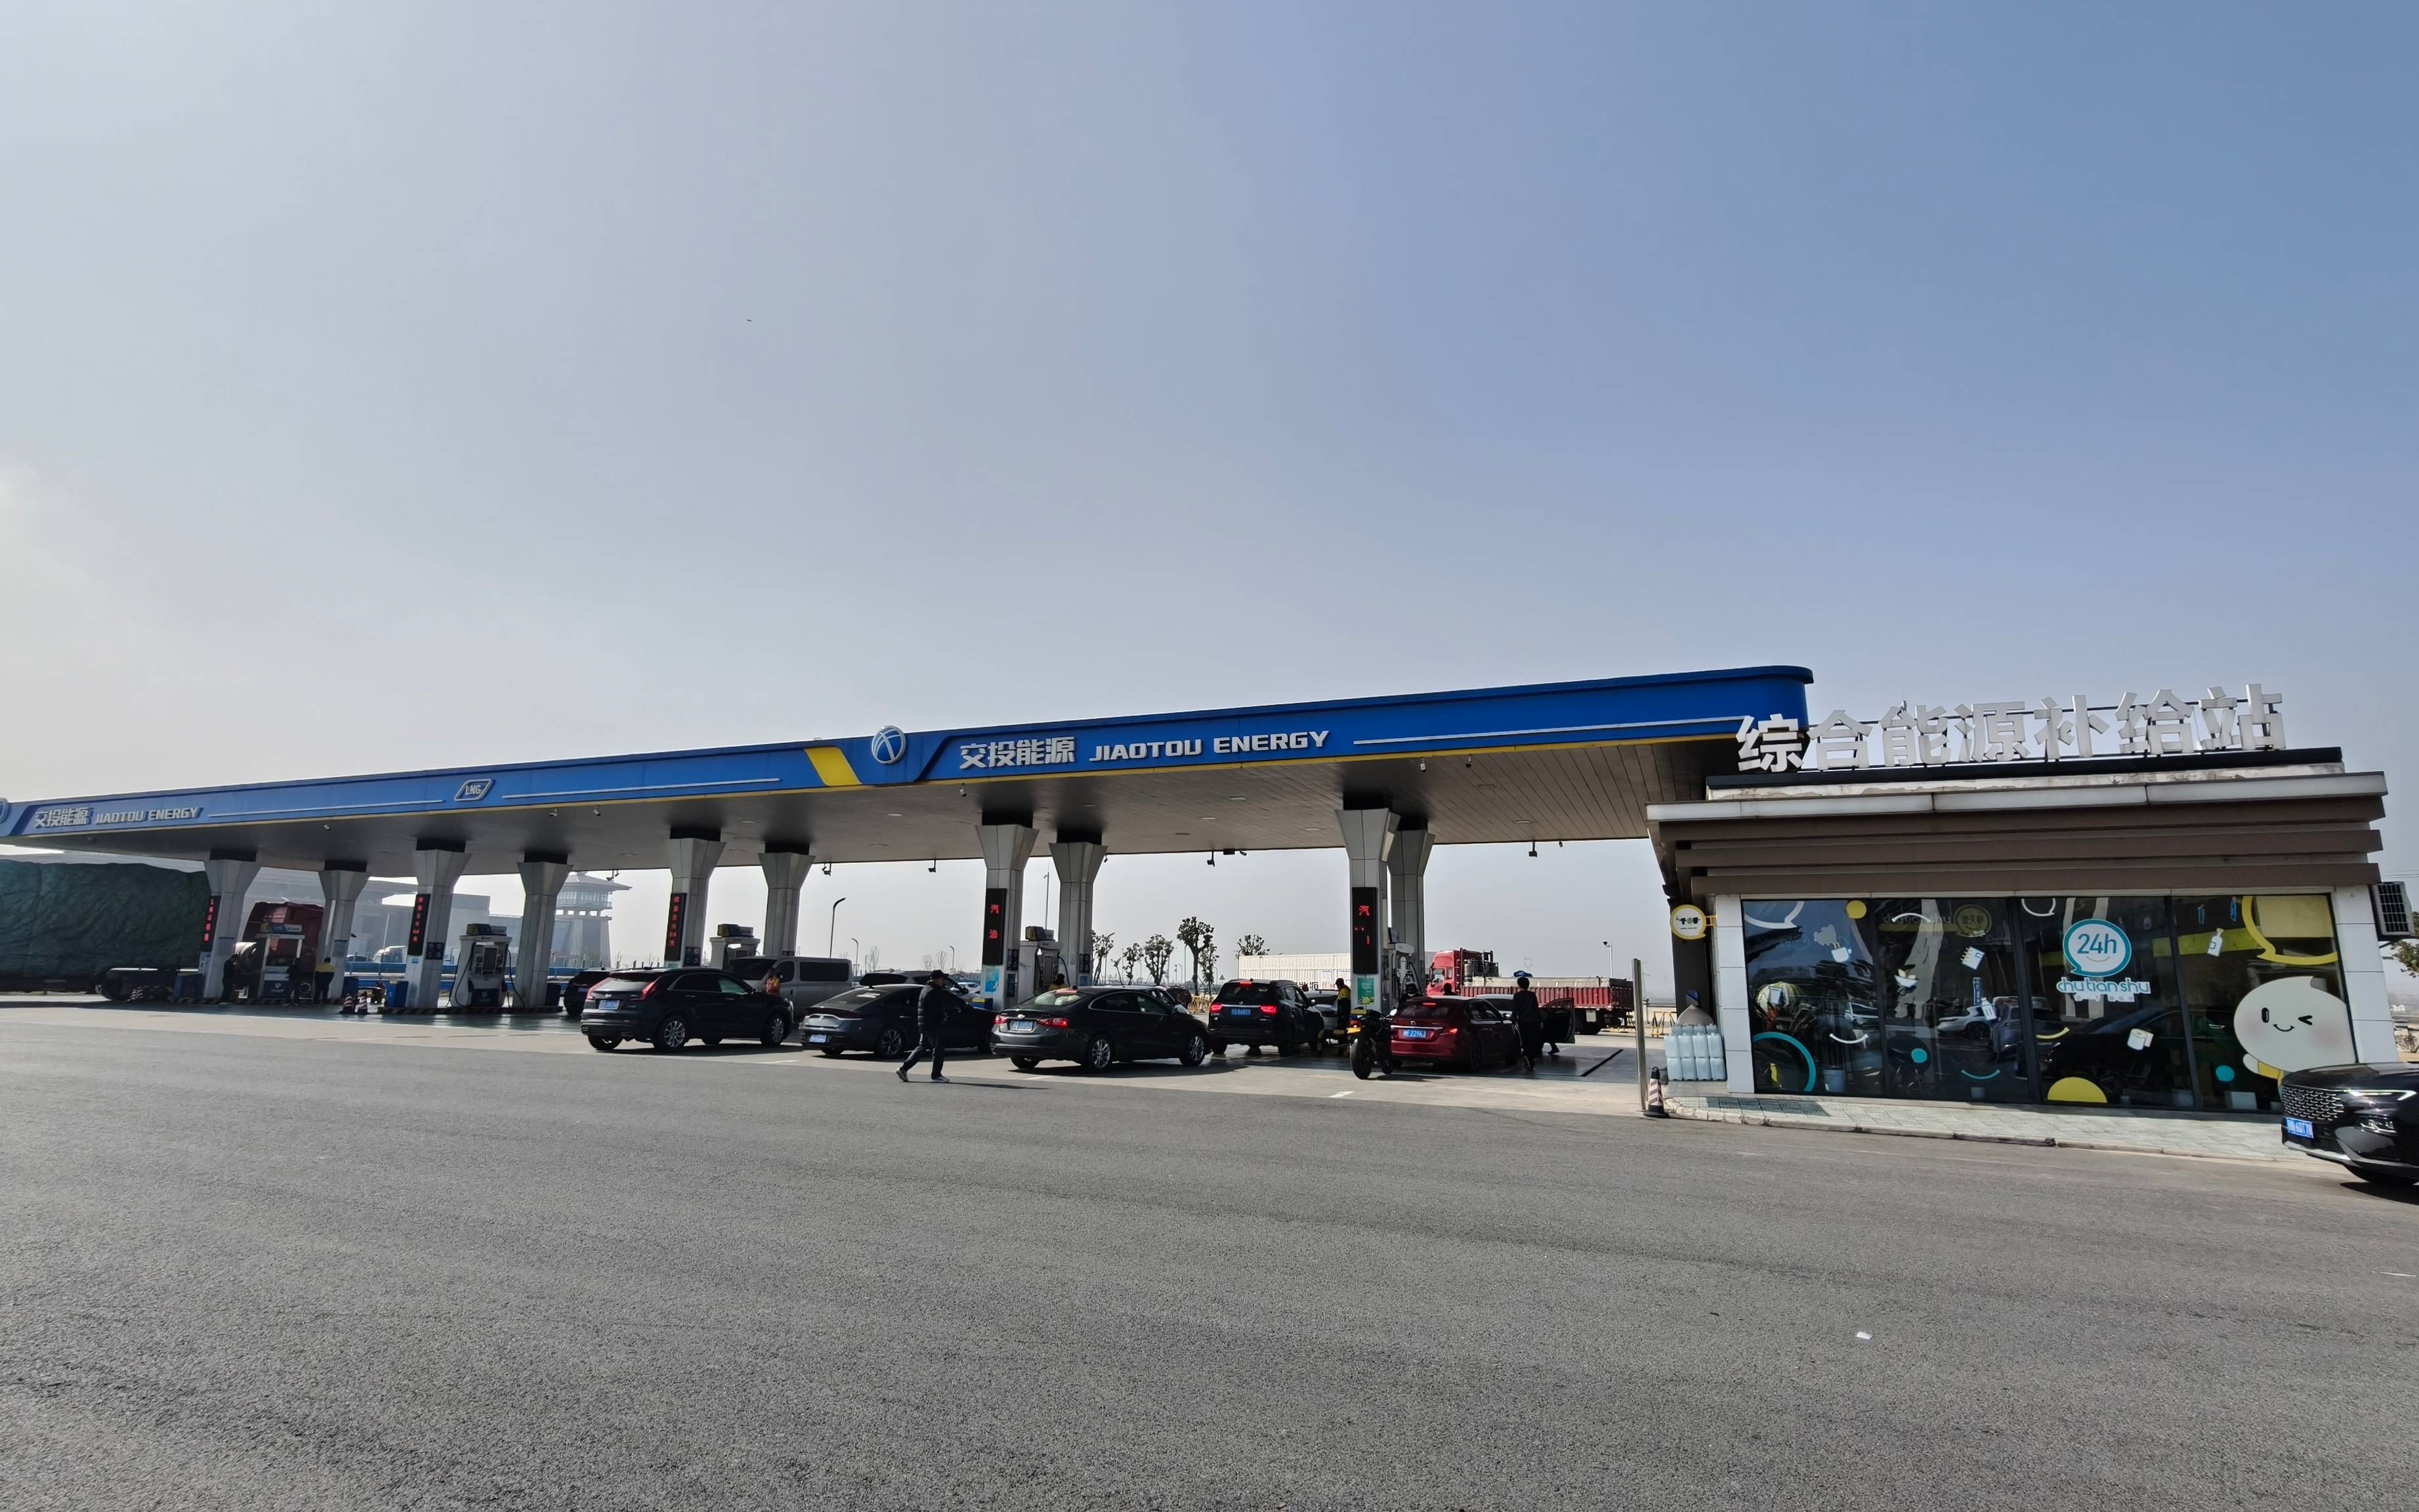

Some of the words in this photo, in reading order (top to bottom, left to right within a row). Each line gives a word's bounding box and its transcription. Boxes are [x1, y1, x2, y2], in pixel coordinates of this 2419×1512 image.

[1736, 683, 2286, 772] 综合能源补给站
[959, 736, 1076, 770] 交投能源
[1089, 739, 1202, 762] JIAOTOU
[1213, 730, 1330, 754] ENERGY
[465, 785, 482, 795] LNG
[33, 807, 89, 828] 交投能源
[96, 810, 144, 825] JIAOTOU
[148, 807, 200, 821] ENERGY
[2077, 933, 2117, 954] 24h
